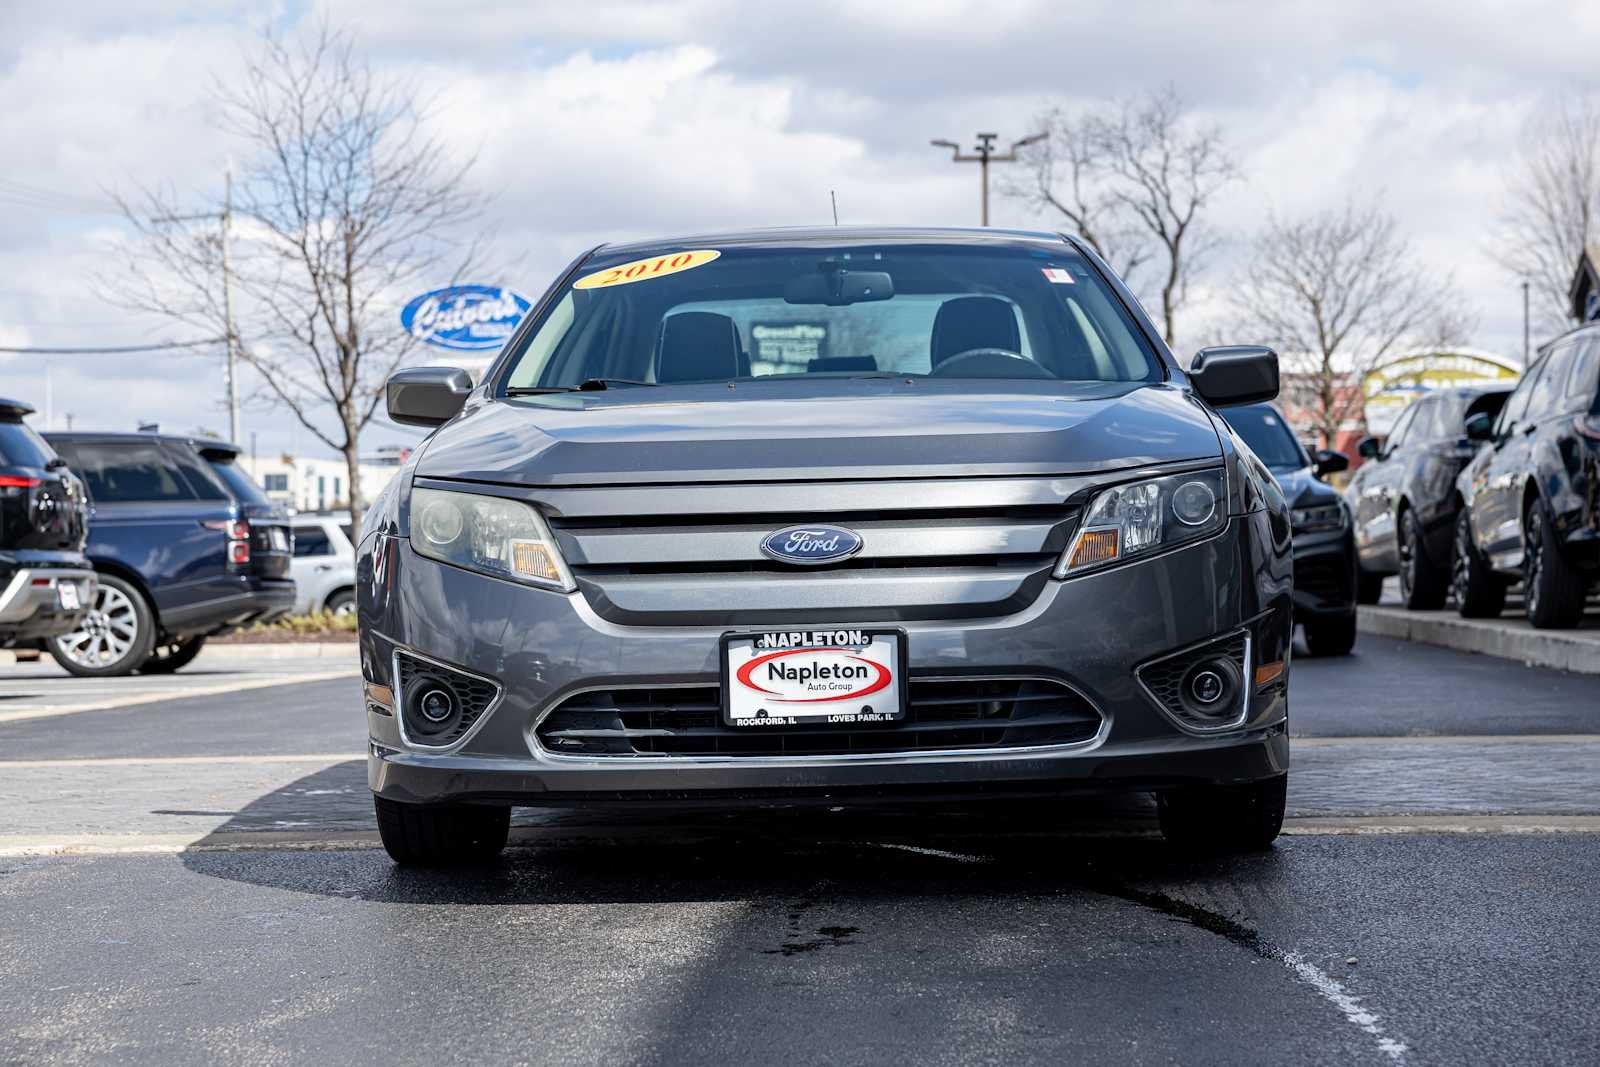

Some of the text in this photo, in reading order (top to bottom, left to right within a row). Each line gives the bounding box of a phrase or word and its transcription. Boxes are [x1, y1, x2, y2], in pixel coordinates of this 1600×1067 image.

[602, 254, 693, 285] 2010
[784, 530, 840, 553] Ford
[763, 630, 862, 648] NAPLETON
[768, 661, 868, 684] Napleton
[807, 681, 853, 692] Auto Group
[788, 716, 797, 725] IL
[827, 714, 856, 723] LOVES
[885, 712, 894, 721] IL
